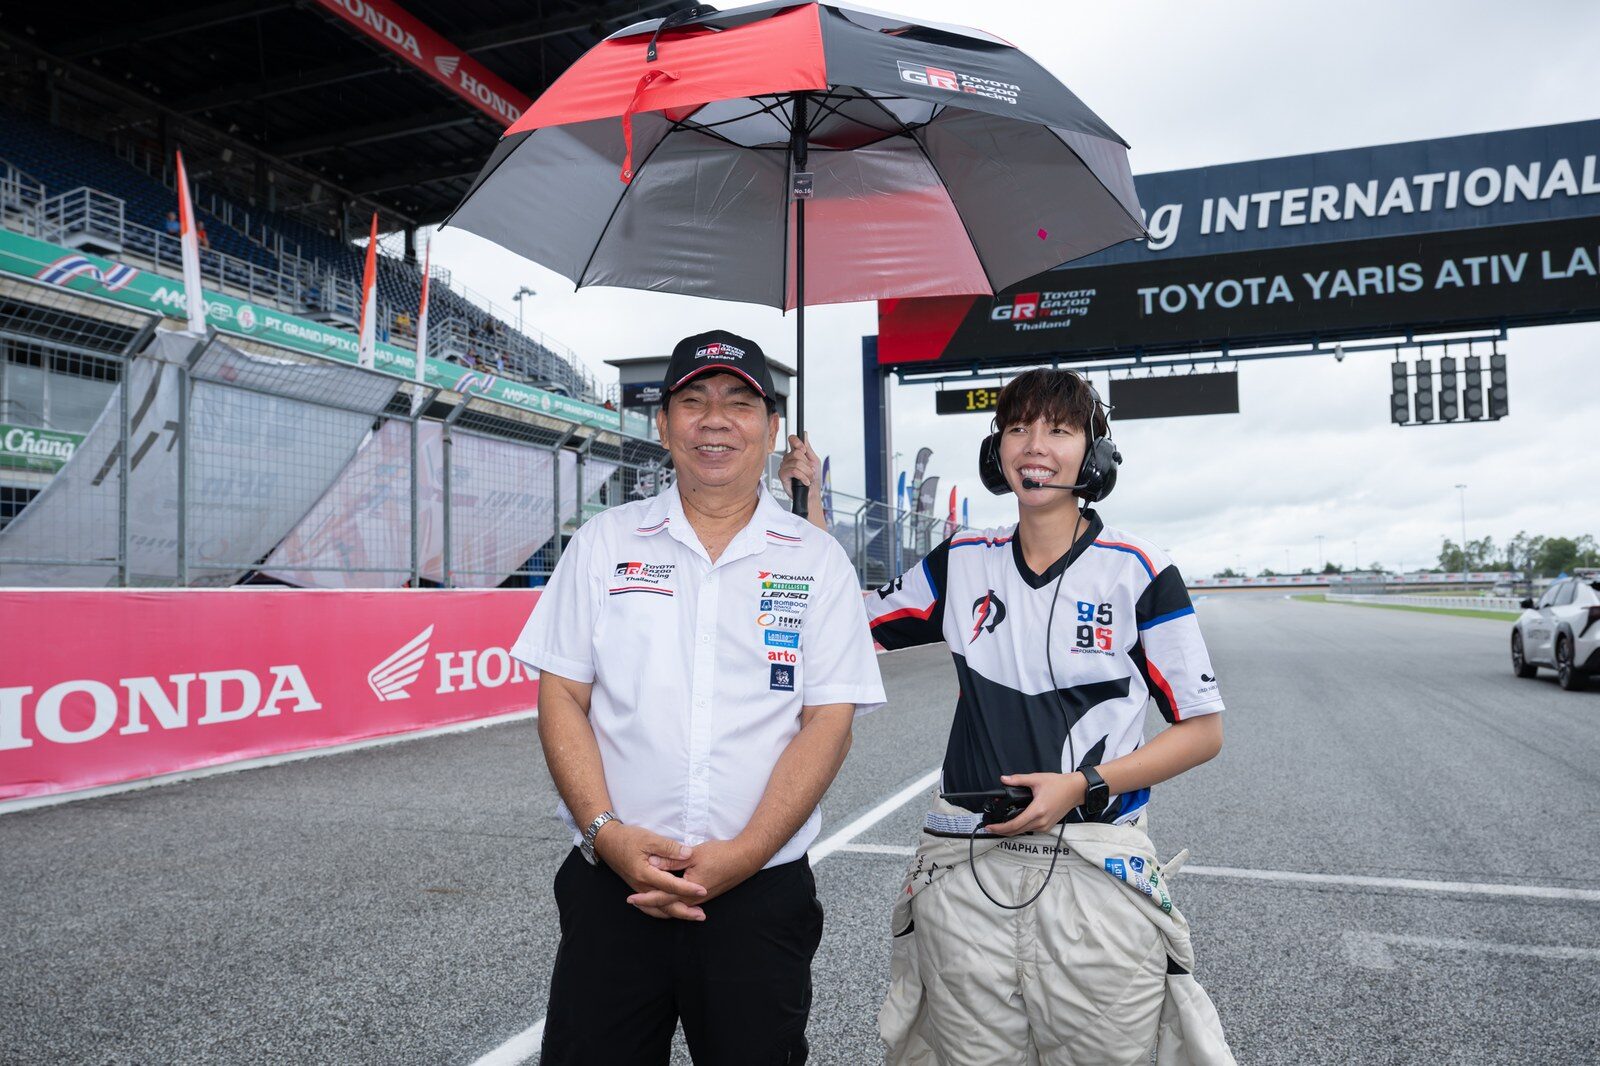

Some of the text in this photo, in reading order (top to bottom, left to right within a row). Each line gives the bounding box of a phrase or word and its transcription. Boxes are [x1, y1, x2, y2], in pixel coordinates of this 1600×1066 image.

[901, 69, 959, 91] GR
[957, 73, 1021, 91] TOYOTA
[960, 81, 1019, 97] GAZOO
[962, 87, 1018, 105] Racing
[1199, 154, 1600, 235] INTERNATIONAL
[1137, 246, 1600, 315] TOYOTA YARIS ATIV LA
[1042, 288, 1096, 301] TOYOTA
[1040, 297, 1091, 309] GAZOO
[991, 303, 1036, 321] GR
[1039, 306, 1088, 317] Racing
[1013, 319, 1071, 332] Thailand
[625, 576, 659, 584] Thailand
[771, 573, 815, 582] YOKOHAMA
[761, 591, 809, 600] LENSO
[768, 650, 797, 663] arto
[996, 840, 1039, 855] TNAPHA
